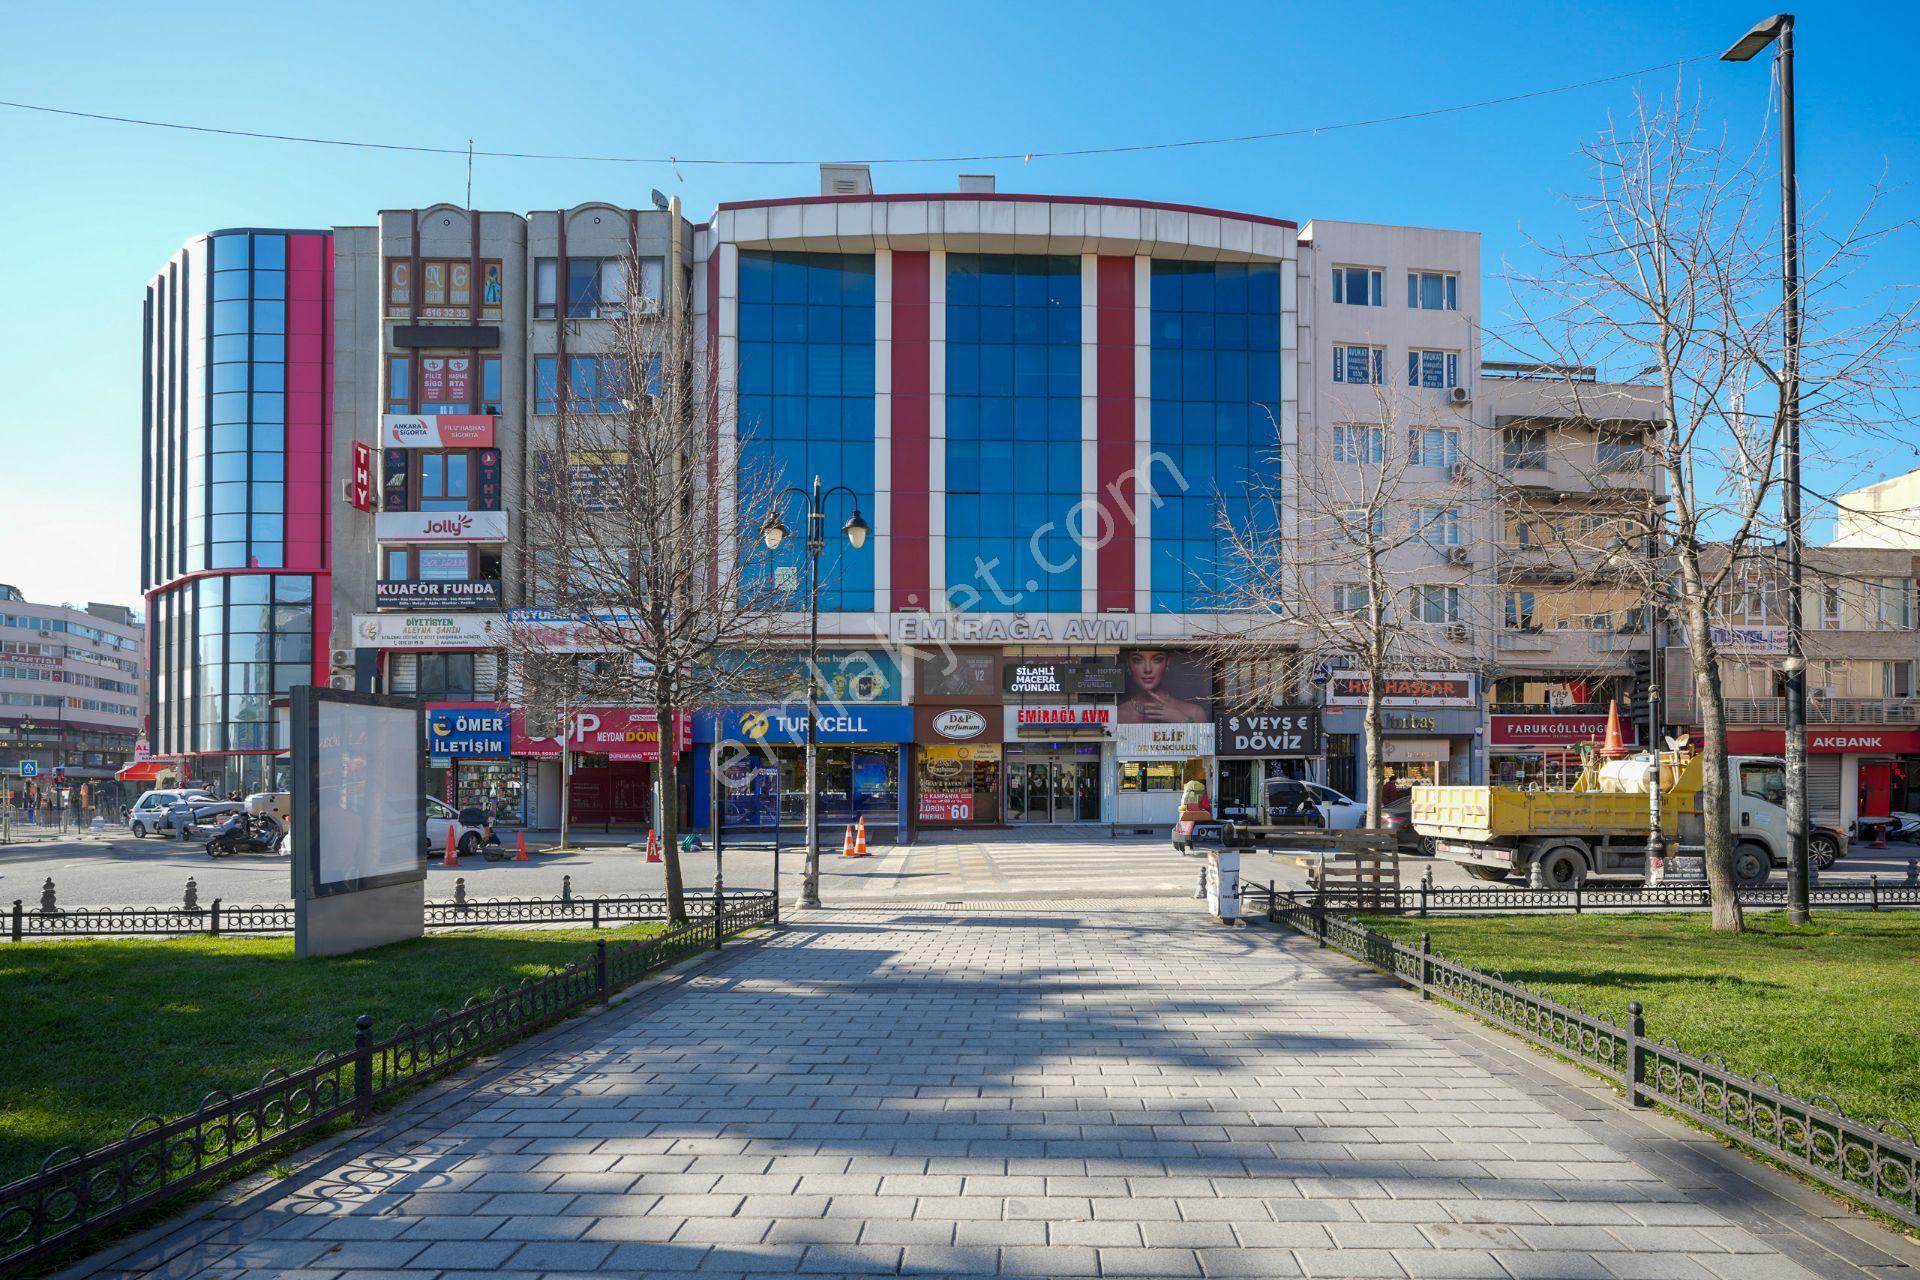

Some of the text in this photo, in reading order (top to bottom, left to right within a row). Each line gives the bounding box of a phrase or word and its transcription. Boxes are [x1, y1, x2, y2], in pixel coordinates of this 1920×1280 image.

[356, 446, 368, 505] THY
[423, 519, 462, 536] Jolly
[377, 581, 494, 595] KUAFÖR FUNDA
[406, 617, 454, 627] DİYETİSYEN
[1063, 619, 1129, 641] AVM
[1011, 683, 1061, 692] OYUNLARI
[949, 714, 972, 723] D&P
[1017, 706, 1110, 723] EMİRAĞA AVM
[456, 715, 504, 733] ÖMER
[1246, 716, 1292, 730] VEYS
[596, 731, 625, 742] MEYDAN
[1152, 728, 1185, 742] ELİF
[1235, 730, 1302, 750] DÖVİZ
[1812, 737, 1883, 747] AKBANK
[434, 738, 502, 754] İLETİŞİM
